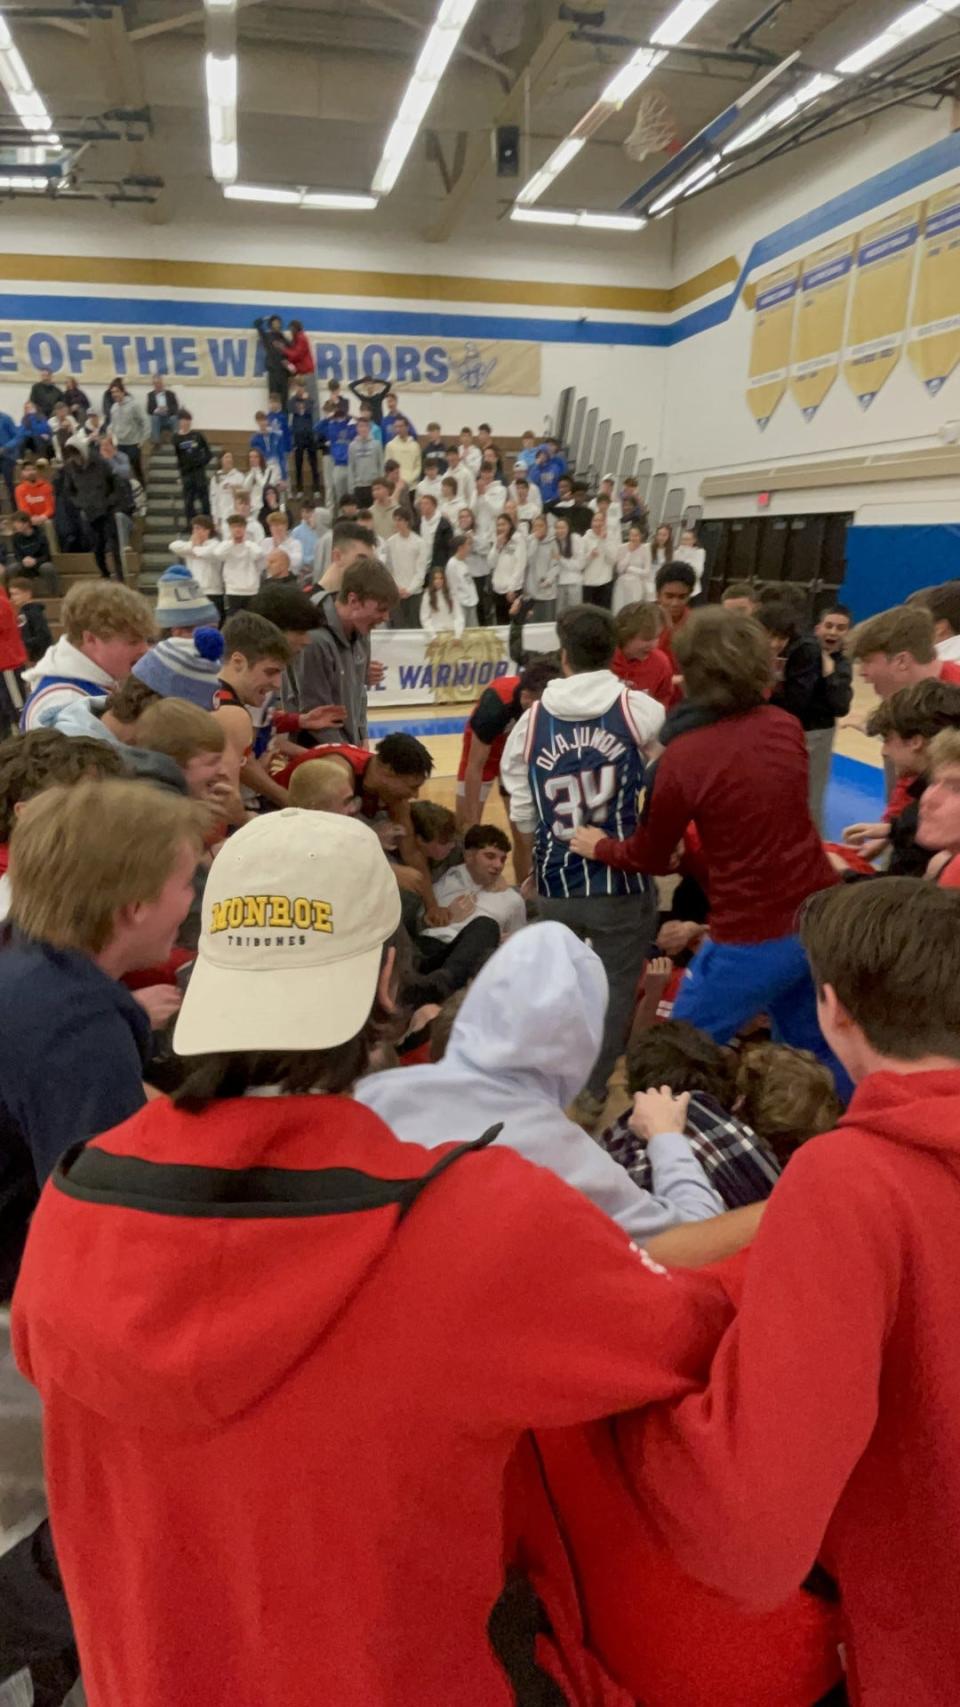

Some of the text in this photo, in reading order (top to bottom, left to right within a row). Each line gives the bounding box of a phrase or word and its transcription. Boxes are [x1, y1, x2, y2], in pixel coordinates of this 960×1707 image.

[28, 332, 94, 374] OF
[103, 336, 199, 376] THE
[544, 765, 617, 841] 34
[209, 895, 334, 933] MONROE
